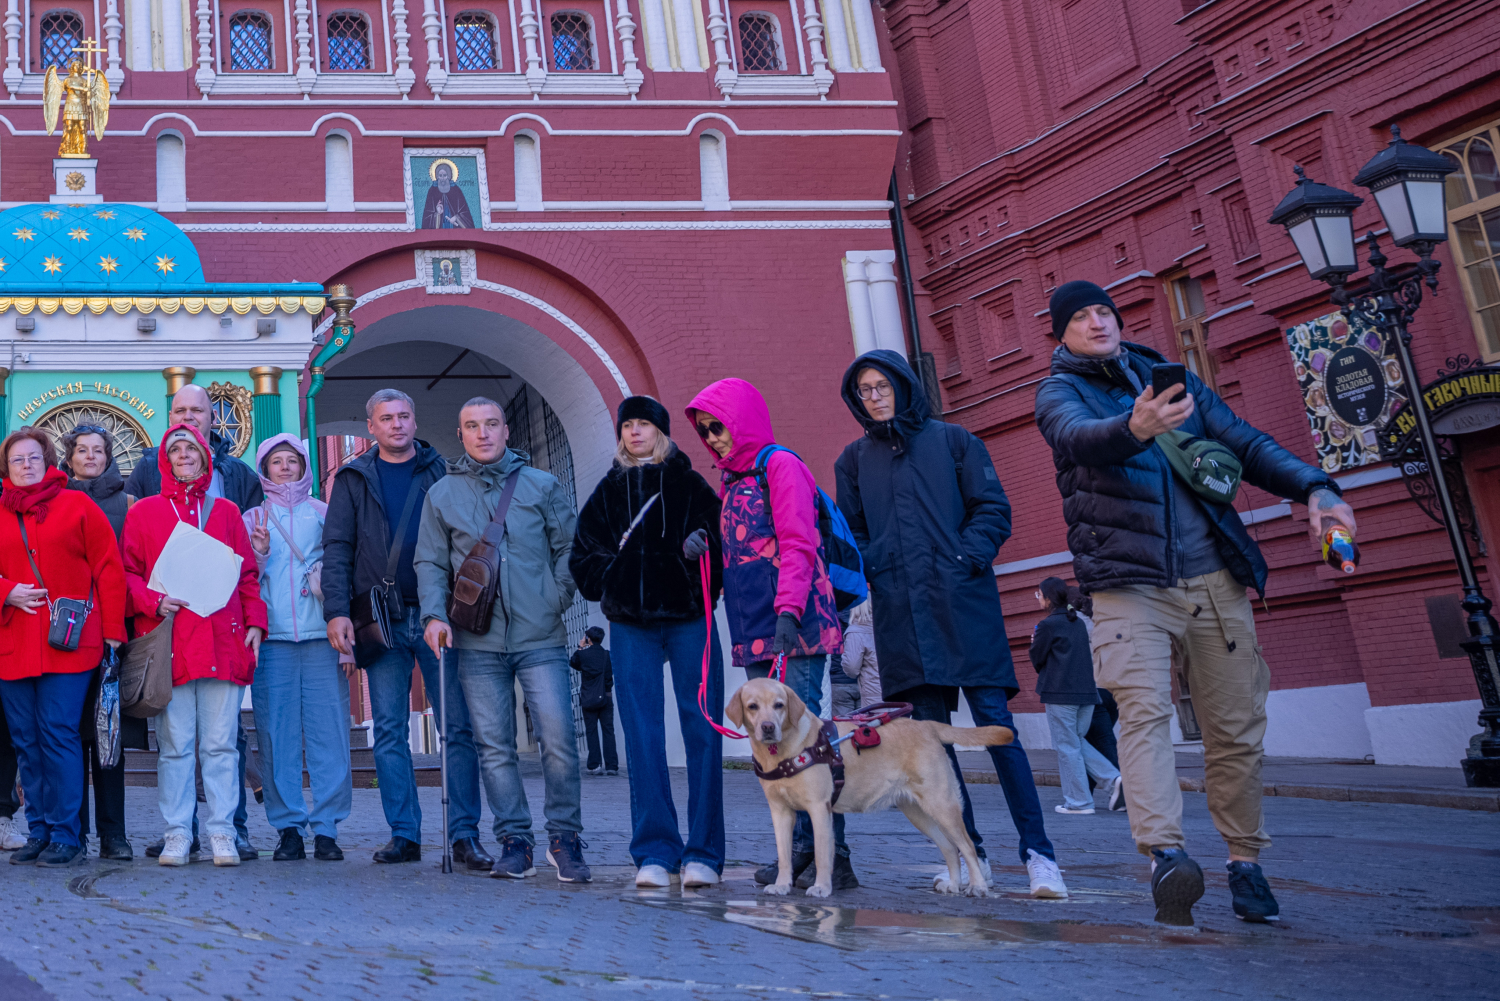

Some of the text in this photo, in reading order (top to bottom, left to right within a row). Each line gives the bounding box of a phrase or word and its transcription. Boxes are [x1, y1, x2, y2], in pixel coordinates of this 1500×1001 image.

[1339, 355, 1355, 366] ГИМ
[1334, 375, 1374, 393] КЛАДОВАЯ
[1336, 368, 1368, 384] ЗОЛОТАЯ
[1337, 384, 1376, 400] ИСТОРИЧЕСКОГО
[17, 381, 156, 421] ИВЕРСКАЯ ЧАСОВНЯ
[1203, 475, 1229, 494] PUMA
